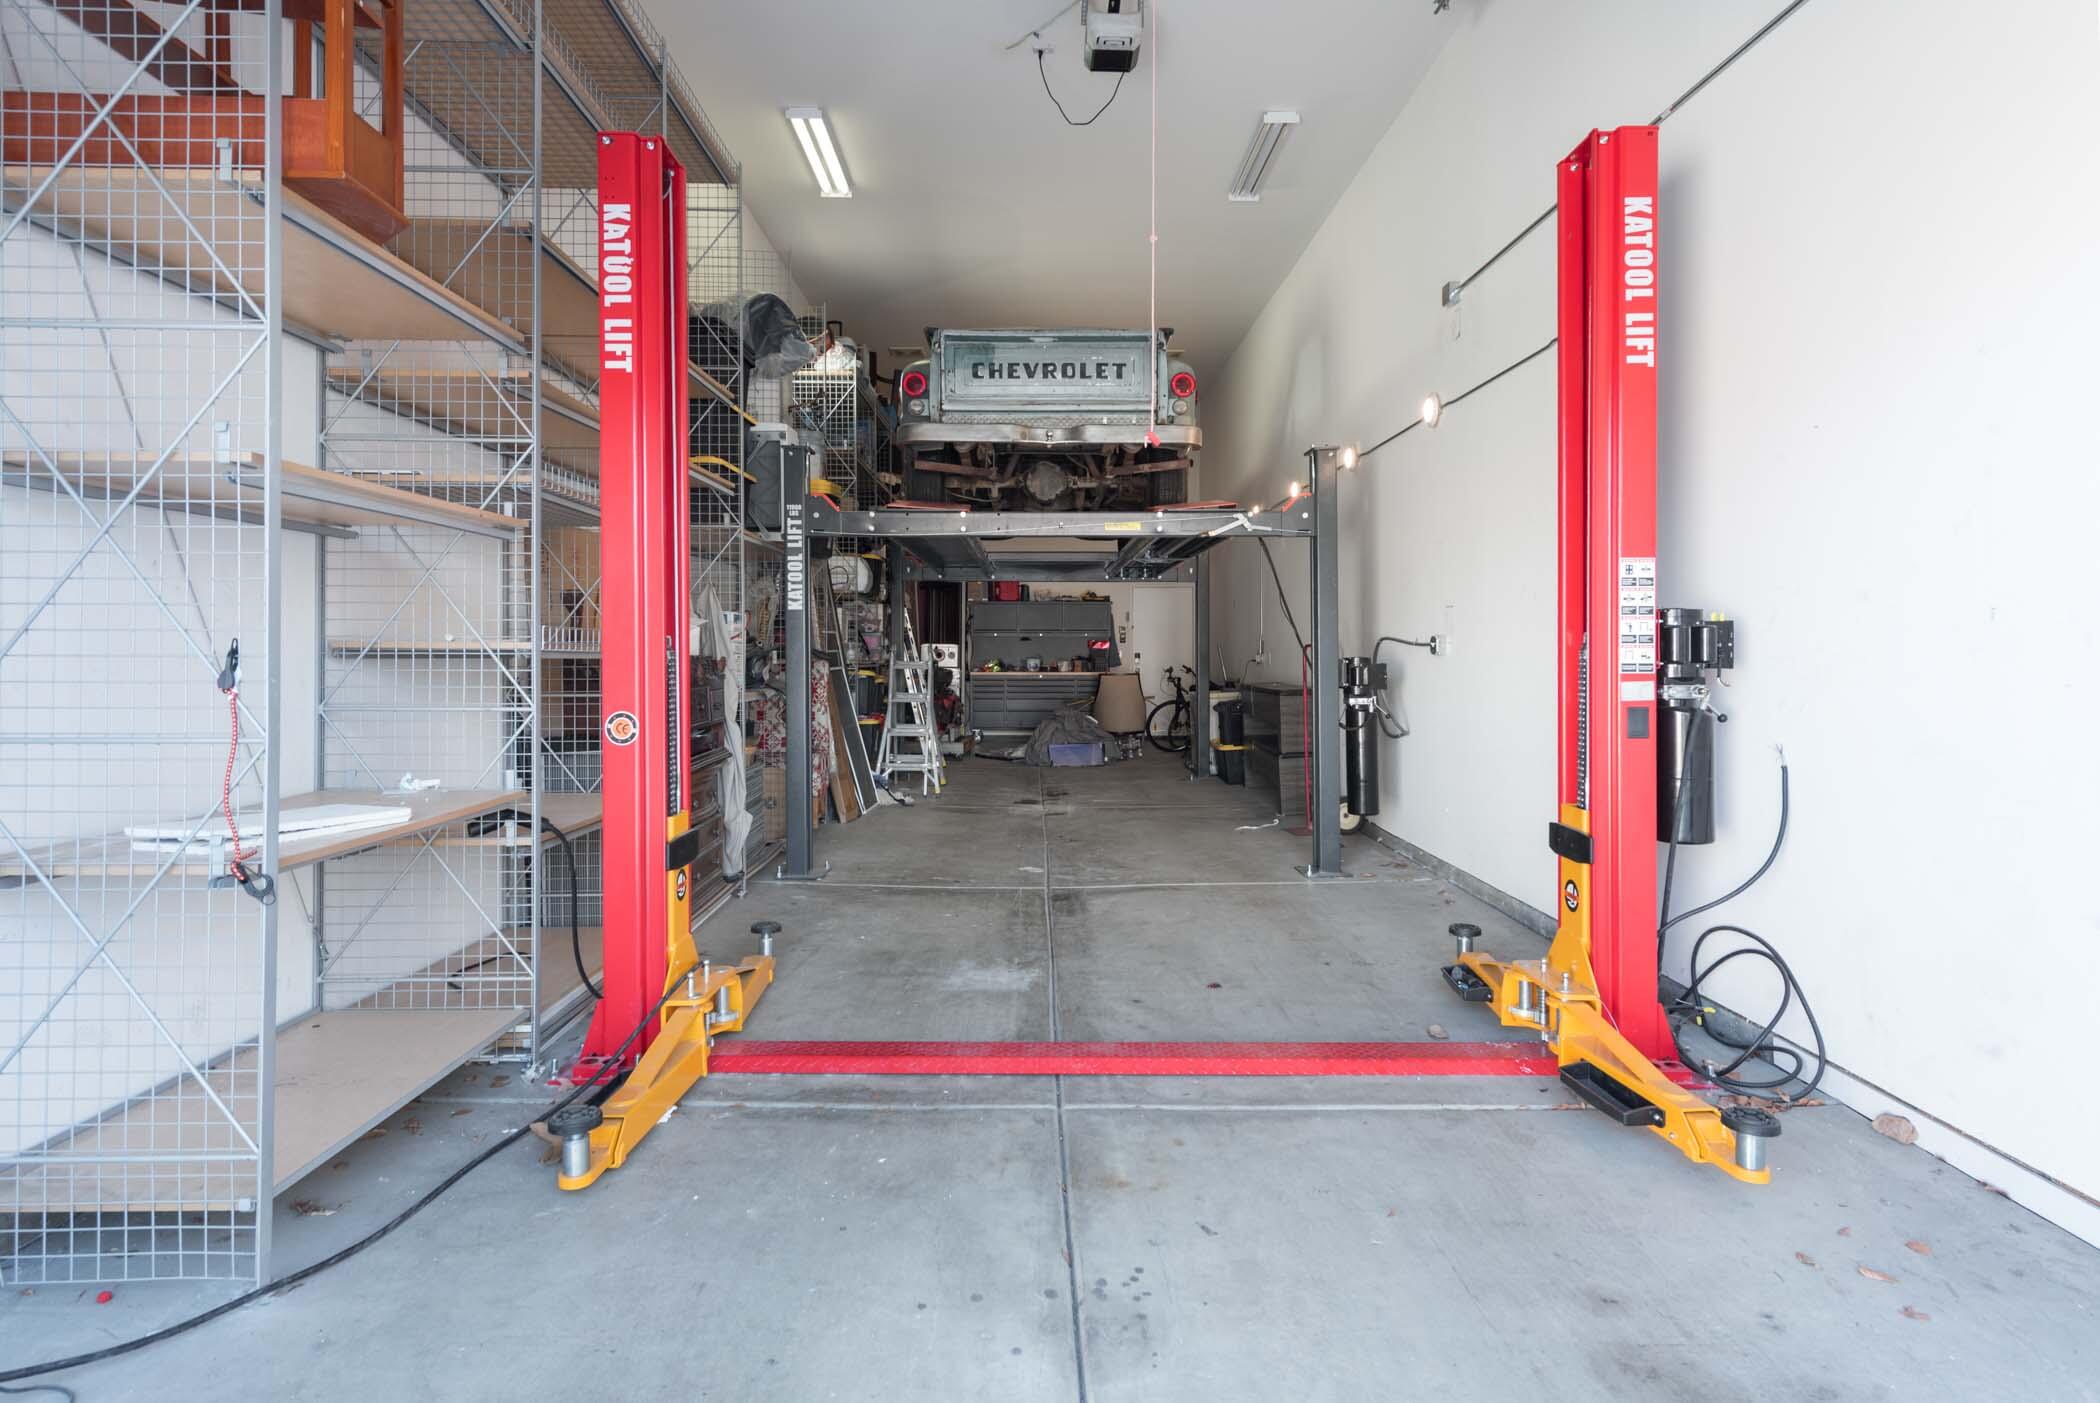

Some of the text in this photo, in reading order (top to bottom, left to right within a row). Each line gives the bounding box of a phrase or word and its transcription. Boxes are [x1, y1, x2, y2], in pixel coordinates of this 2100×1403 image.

[1624, 196, 1654, 368] KATOOL LIFT
[604, 318, 633, 373] LIFT
[971, 362, 1127, 380] CHEVROLET
[786, 517, 803, 611] KATOOL LIFT
